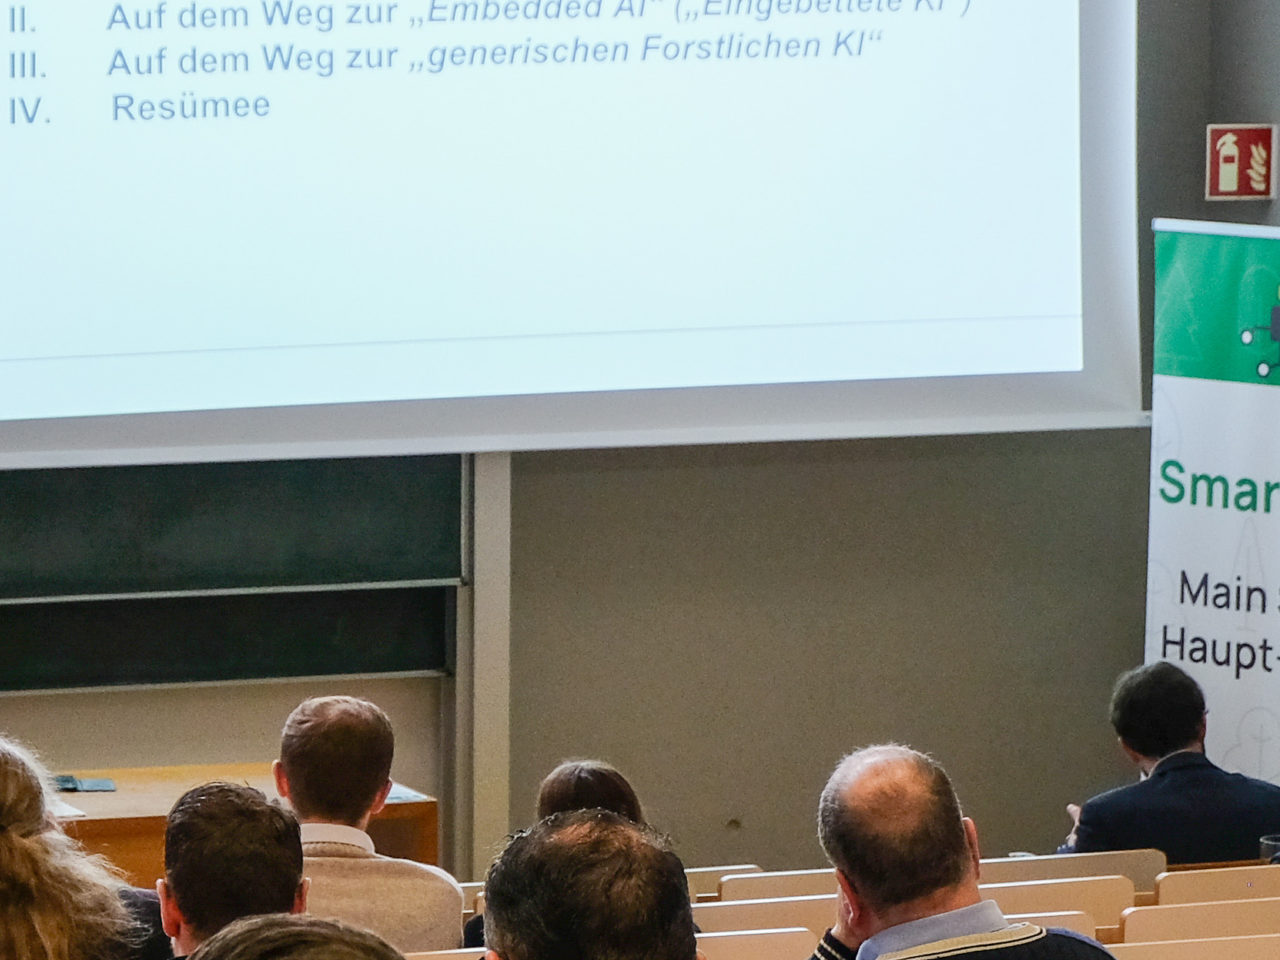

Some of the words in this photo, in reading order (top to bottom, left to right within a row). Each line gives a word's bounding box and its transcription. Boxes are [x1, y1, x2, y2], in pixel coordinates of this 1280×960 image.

[9, 7, 37, 33] II.
[107, 3, 167, 31] Auf
[178, 3, 250, 28] dem
[262, 0, 334, 33] Weg
[346, 2, 399, 25] zur
[614, 0, 663, 18] AI
[9, 51, 47, 79] III.
[107, 47, 167, 76] Auf
[178, 48, 250, 74] dem
[262, 44, 334, 78] Weg
[346, 48, 399, 70] zur
[408, 37, 629, 74] „generischen
[641, 33, 821, 62] Forstlichen
[9, 97, 51, 125] IV.
[112, 92, 271, 121] Resümee
[1160, 460, 1280, 514] Smar
[1180, 570, 1267, 614] Main
